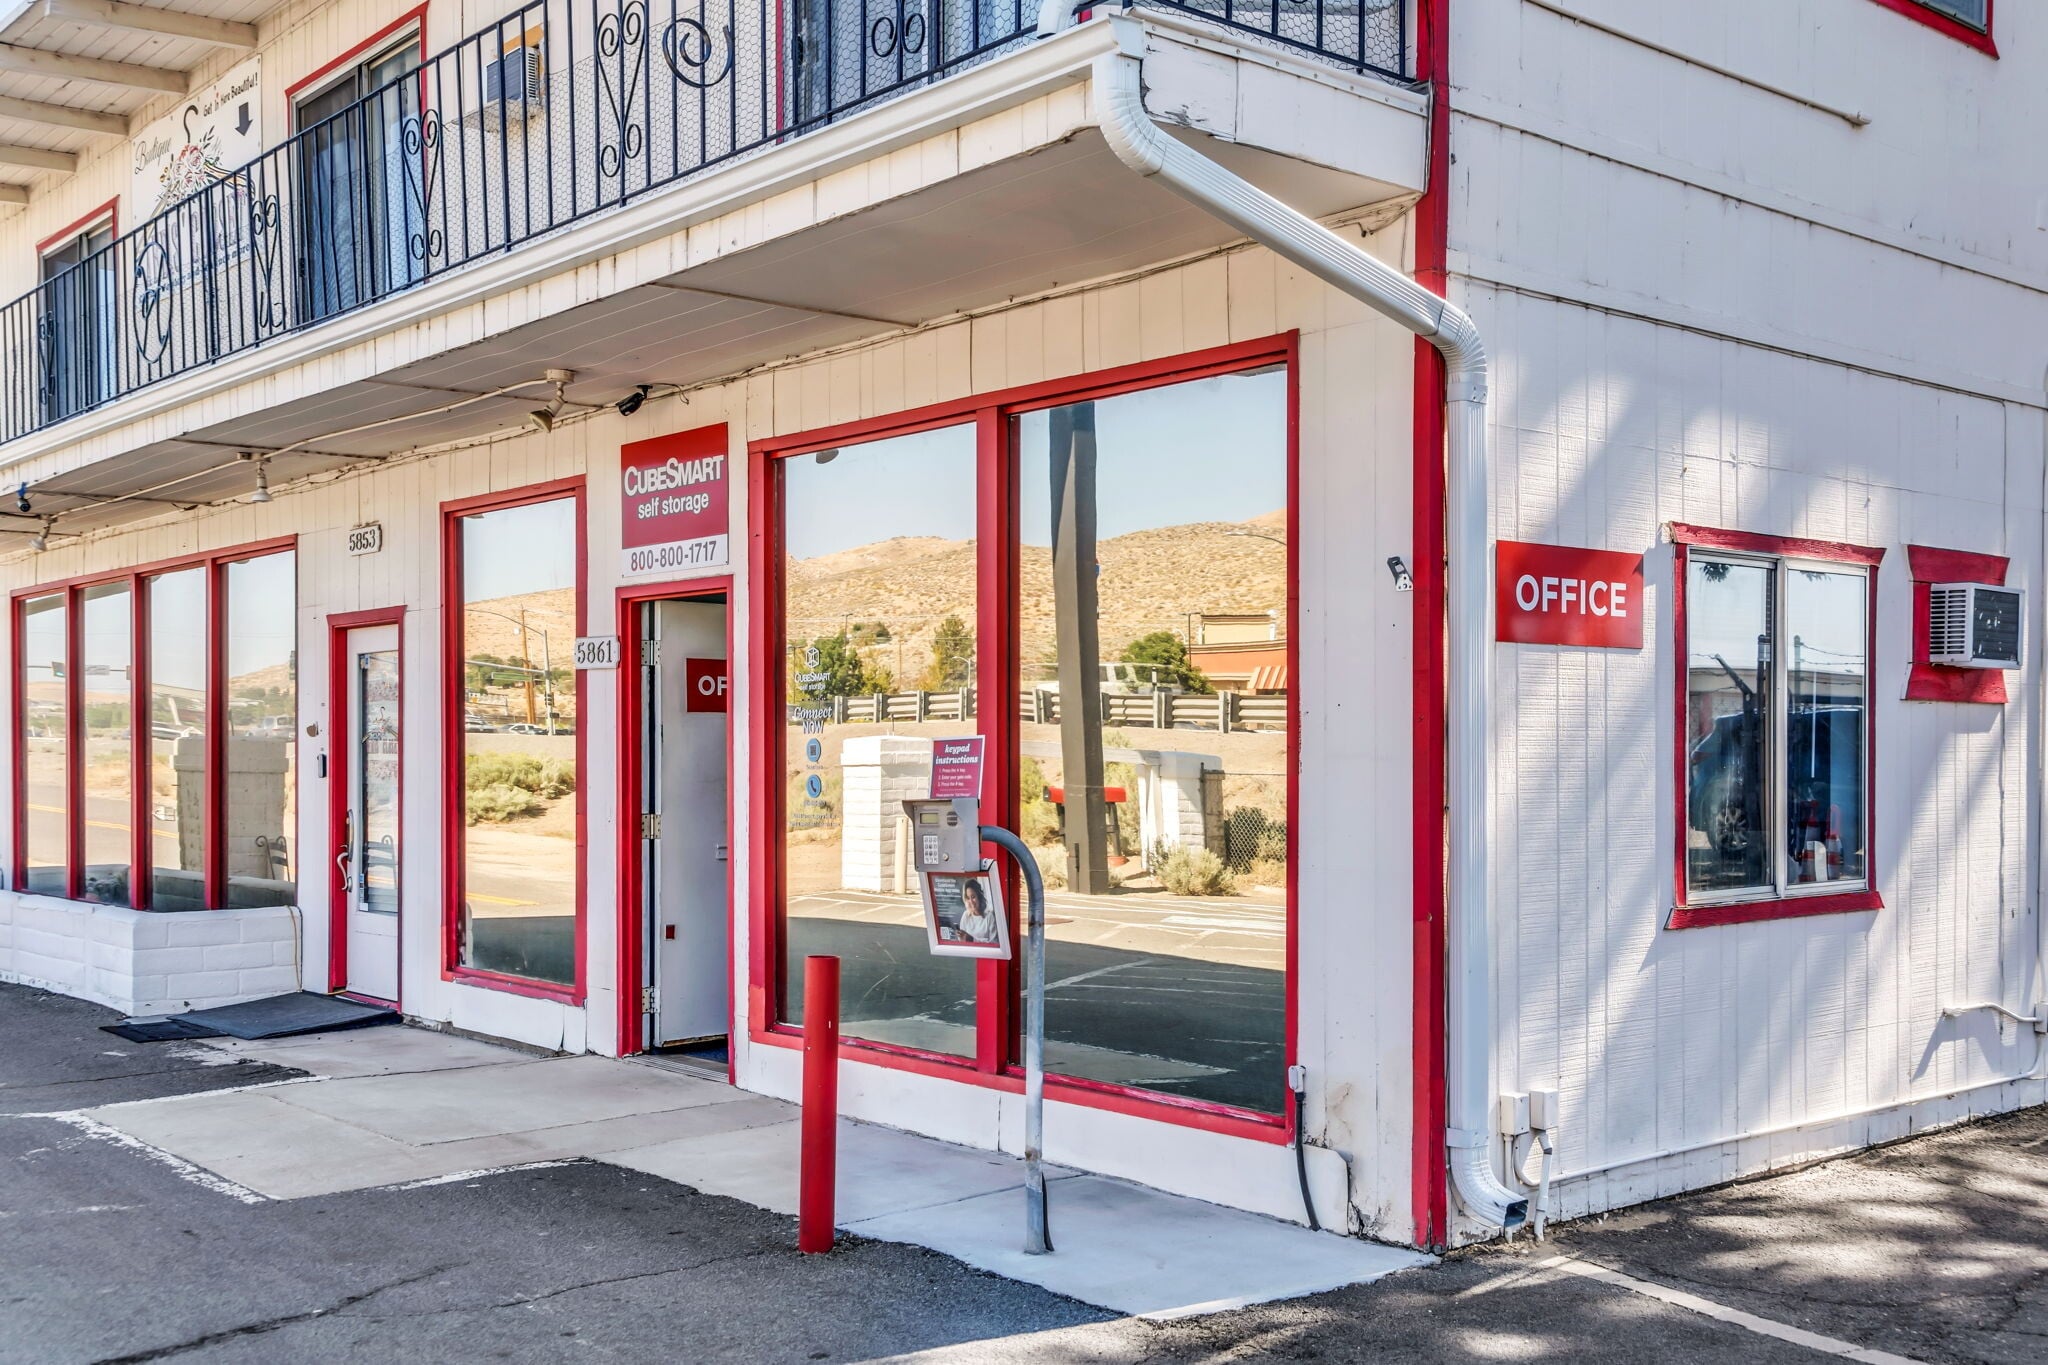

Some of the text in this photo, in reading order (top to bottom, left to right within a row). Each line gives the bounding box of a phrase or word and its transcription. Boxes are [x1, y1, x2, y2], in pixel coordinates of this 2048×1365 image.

[134, 136, 172, 175] Boutique
[637, 492, 710, 520] self storage
[349, 529, 376, 552] 5853
[630, 540, 718, 572] 800-800-1717
[1515, 574, 1628, 618] OFFICE
[576, 640, 613, 664] 5861
[793, 706, 833, 719] Connect
[802, 720, 825, 734] NOW
[935, 755, 979, 764] instructions
[944, 743, 971, 754] keypad
